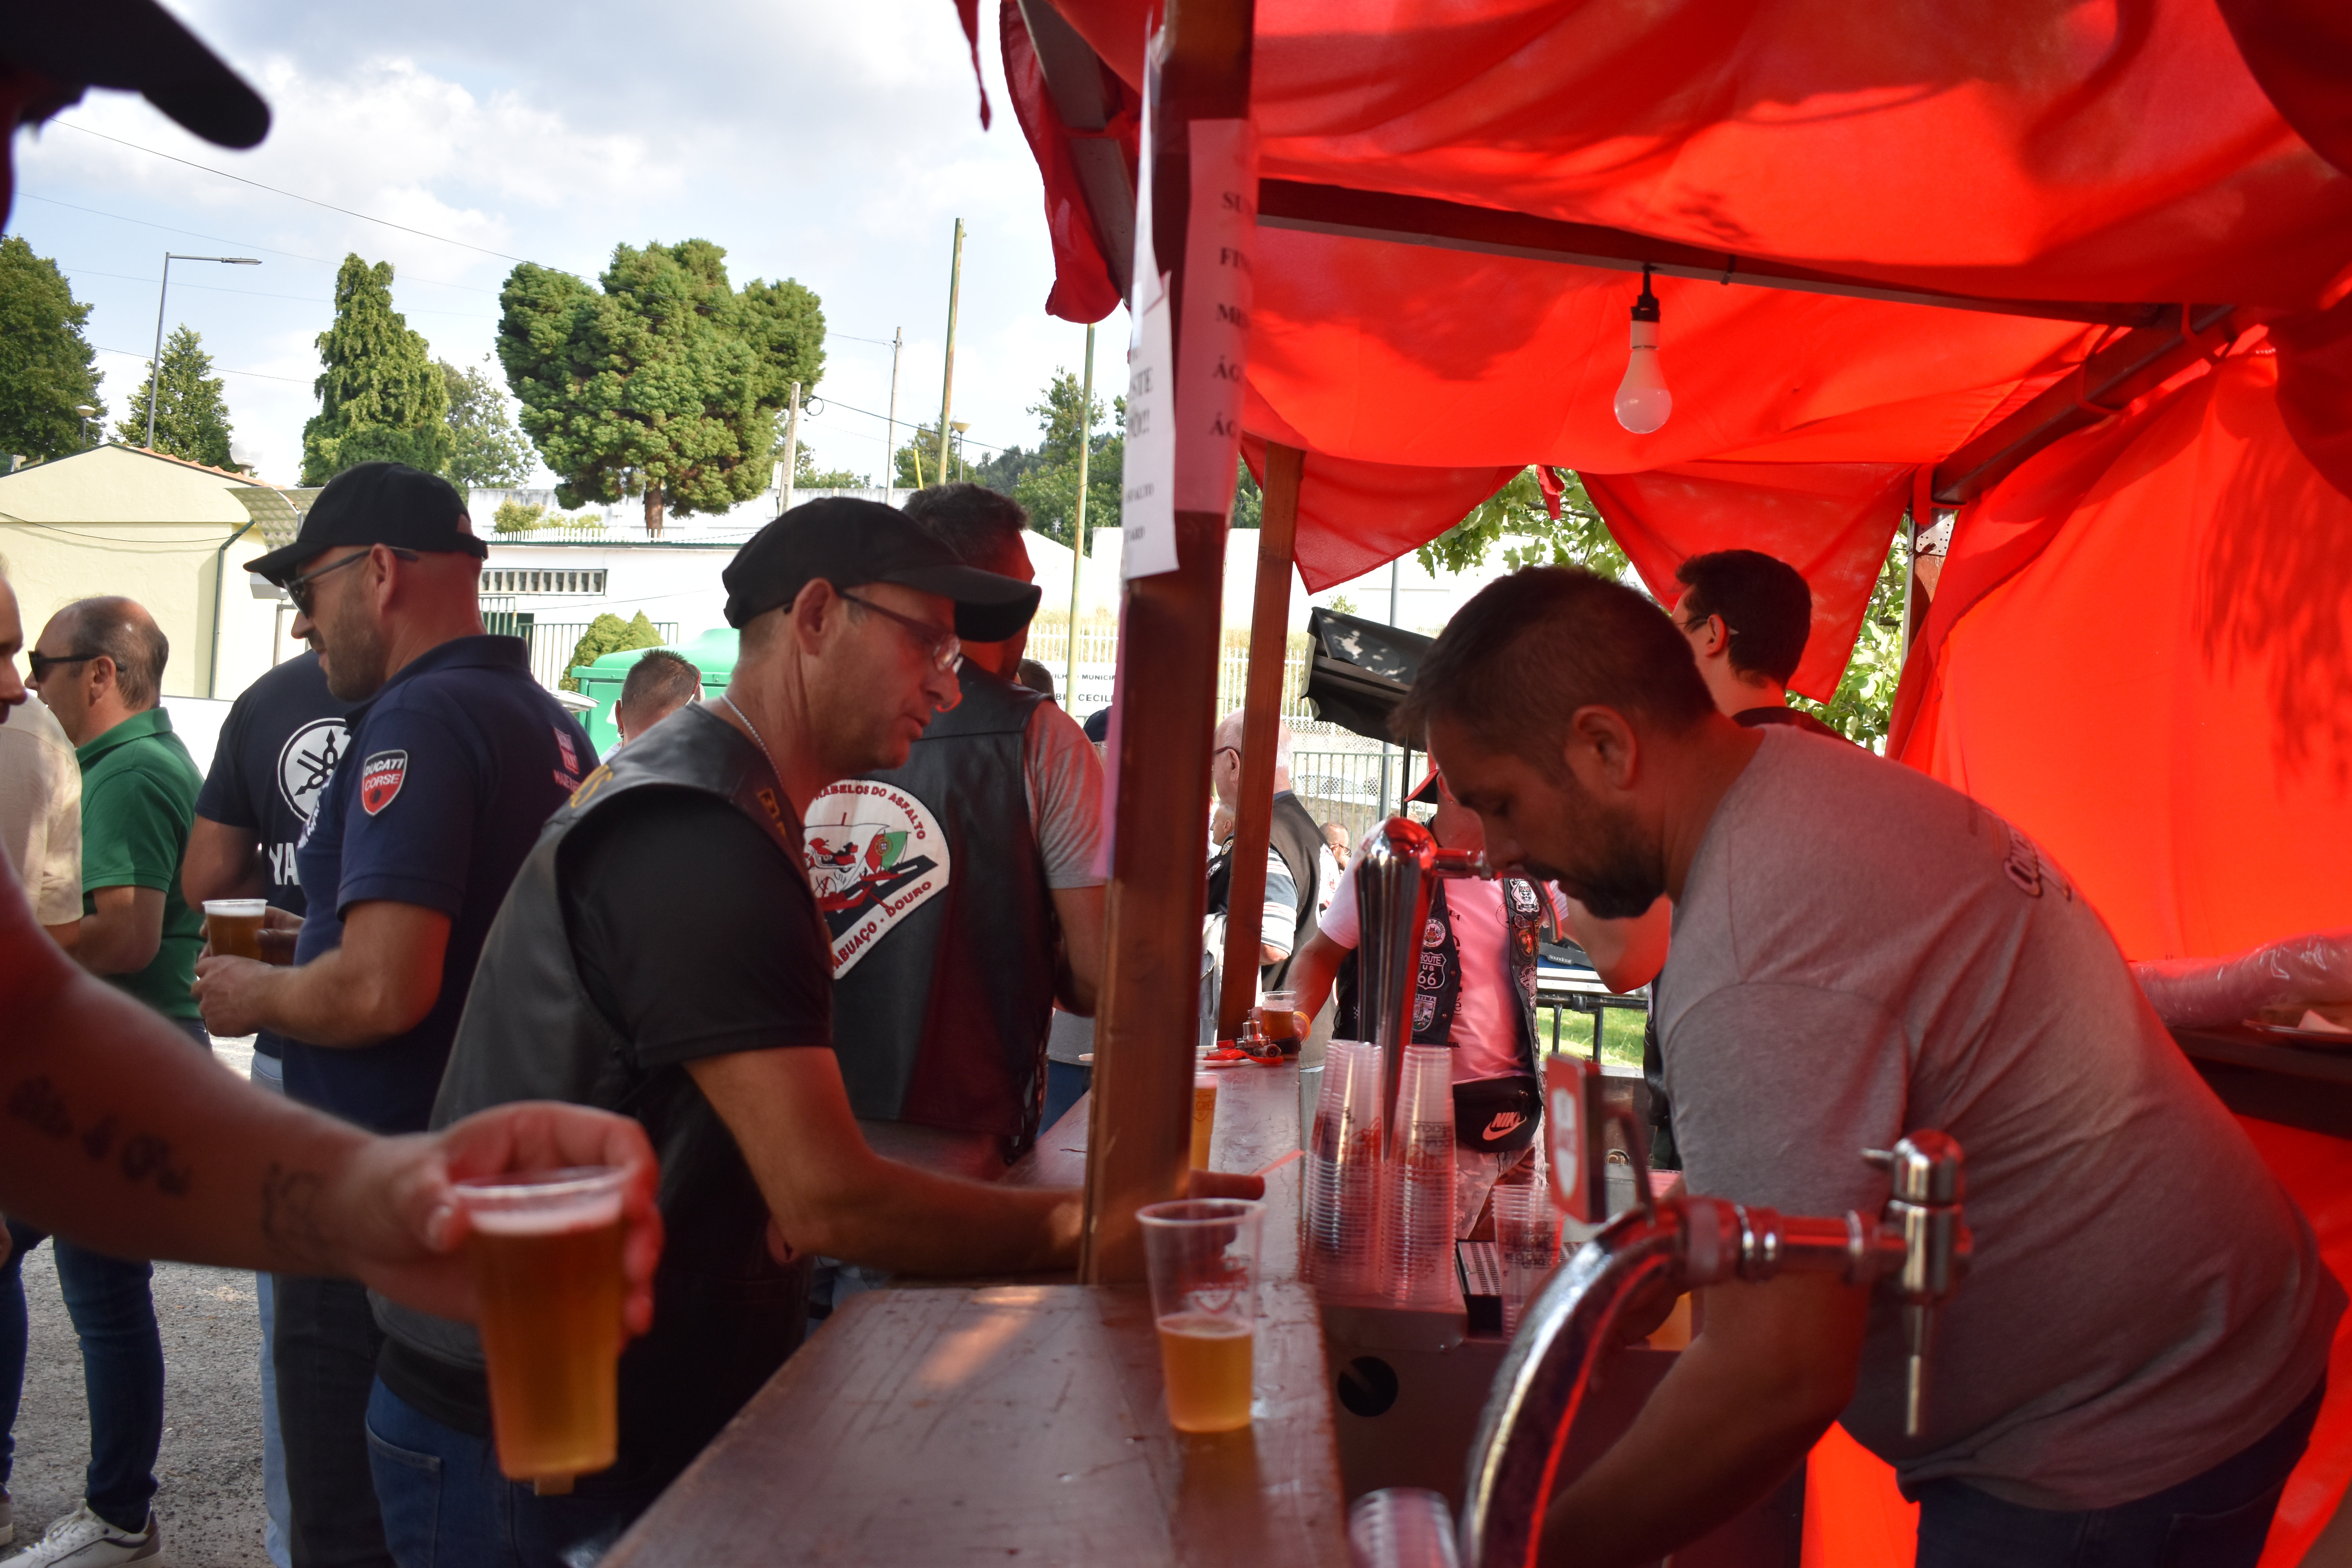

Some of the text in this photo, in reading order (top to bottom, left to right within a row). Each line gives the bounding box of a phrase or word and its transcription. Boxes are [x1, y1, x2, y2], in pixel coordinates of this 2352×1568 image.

[365, 759, 404, 776] DUCATI
[365, 774, 401, 791] CORSE
[871, 786, 887, 797] DO
[888, 793, 926, 840] ASFALTO
[832, 921, 877, 970] ABUAÇO
[885, 881, 932, 918] DOURO
[1420, 954, 1442, 964] ROUTE
[1417, 971, 1436, 986] 66
